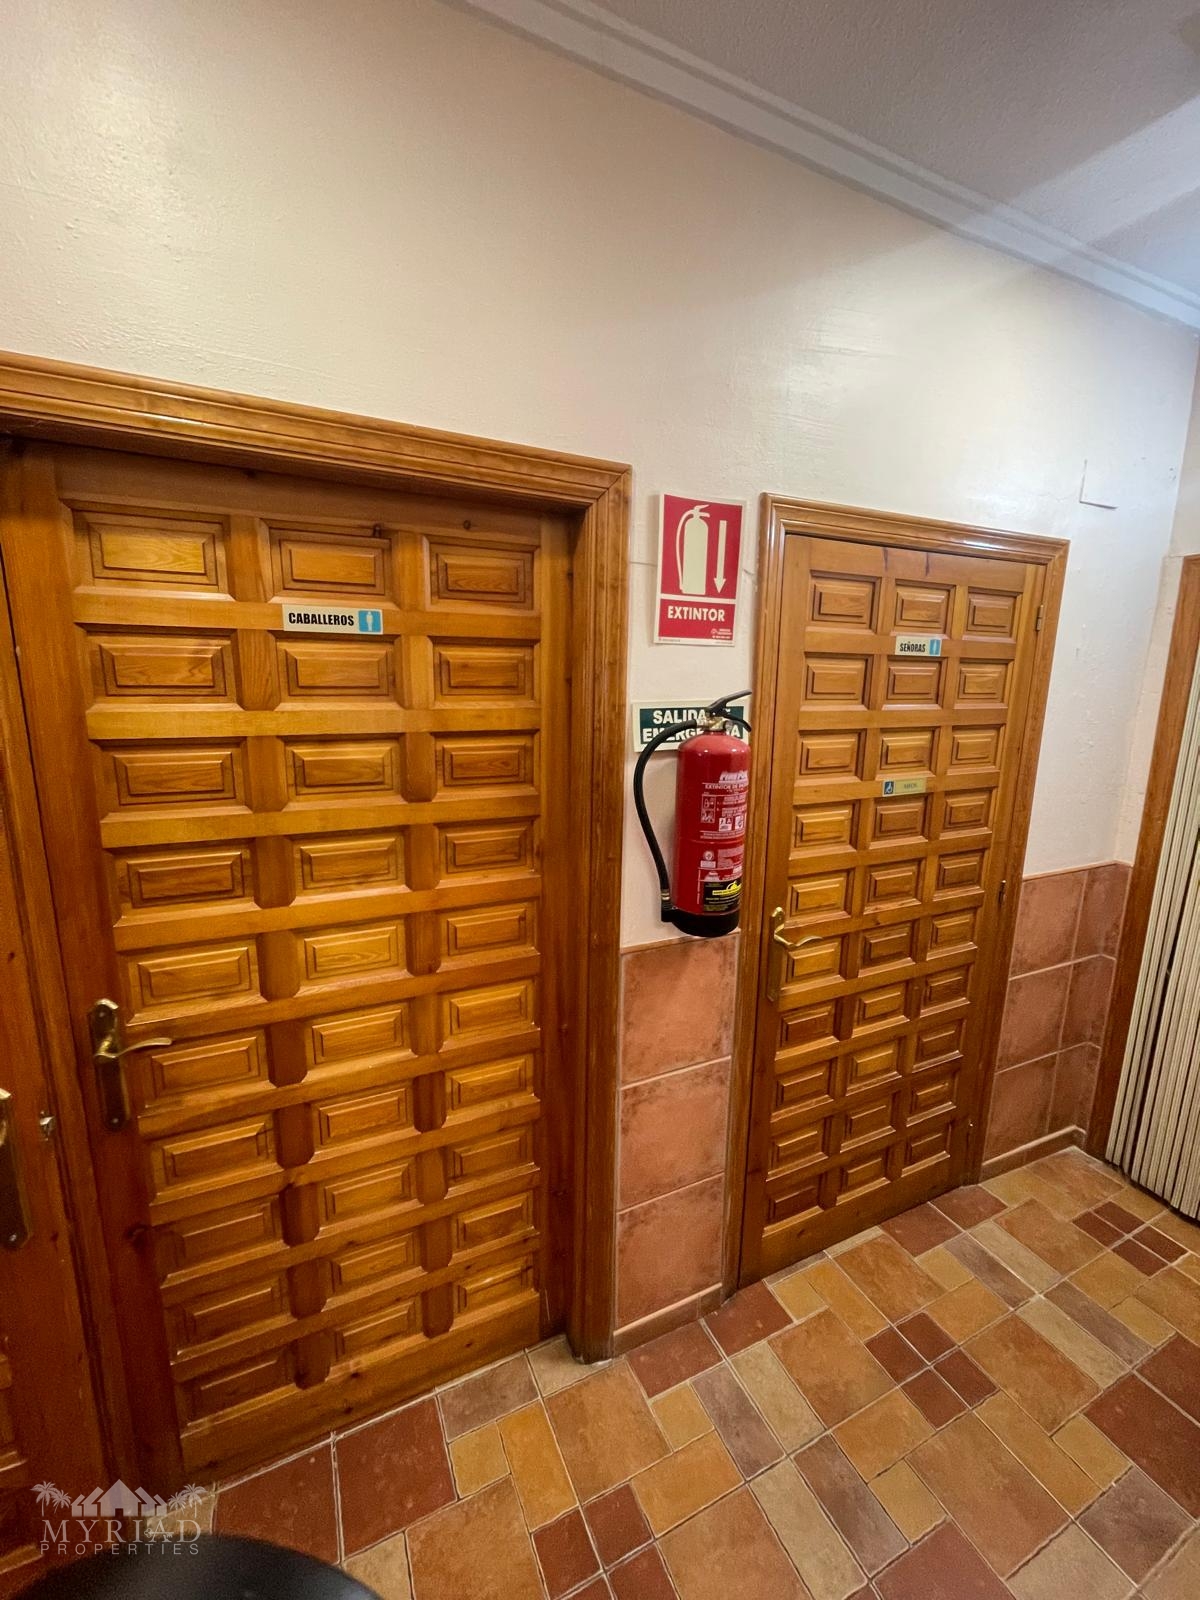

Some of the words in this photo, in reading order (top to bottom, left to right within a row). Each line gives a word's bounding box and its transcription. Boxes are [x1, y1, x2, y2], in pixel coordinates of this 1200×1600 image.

[288, 612, 355, 626] CABALLEROS
[667, 605, 726, 622] EXTINTOR
[899, 641, 926, 653] SEÑORAS
[652, 709, 707, 725] SALIDA
